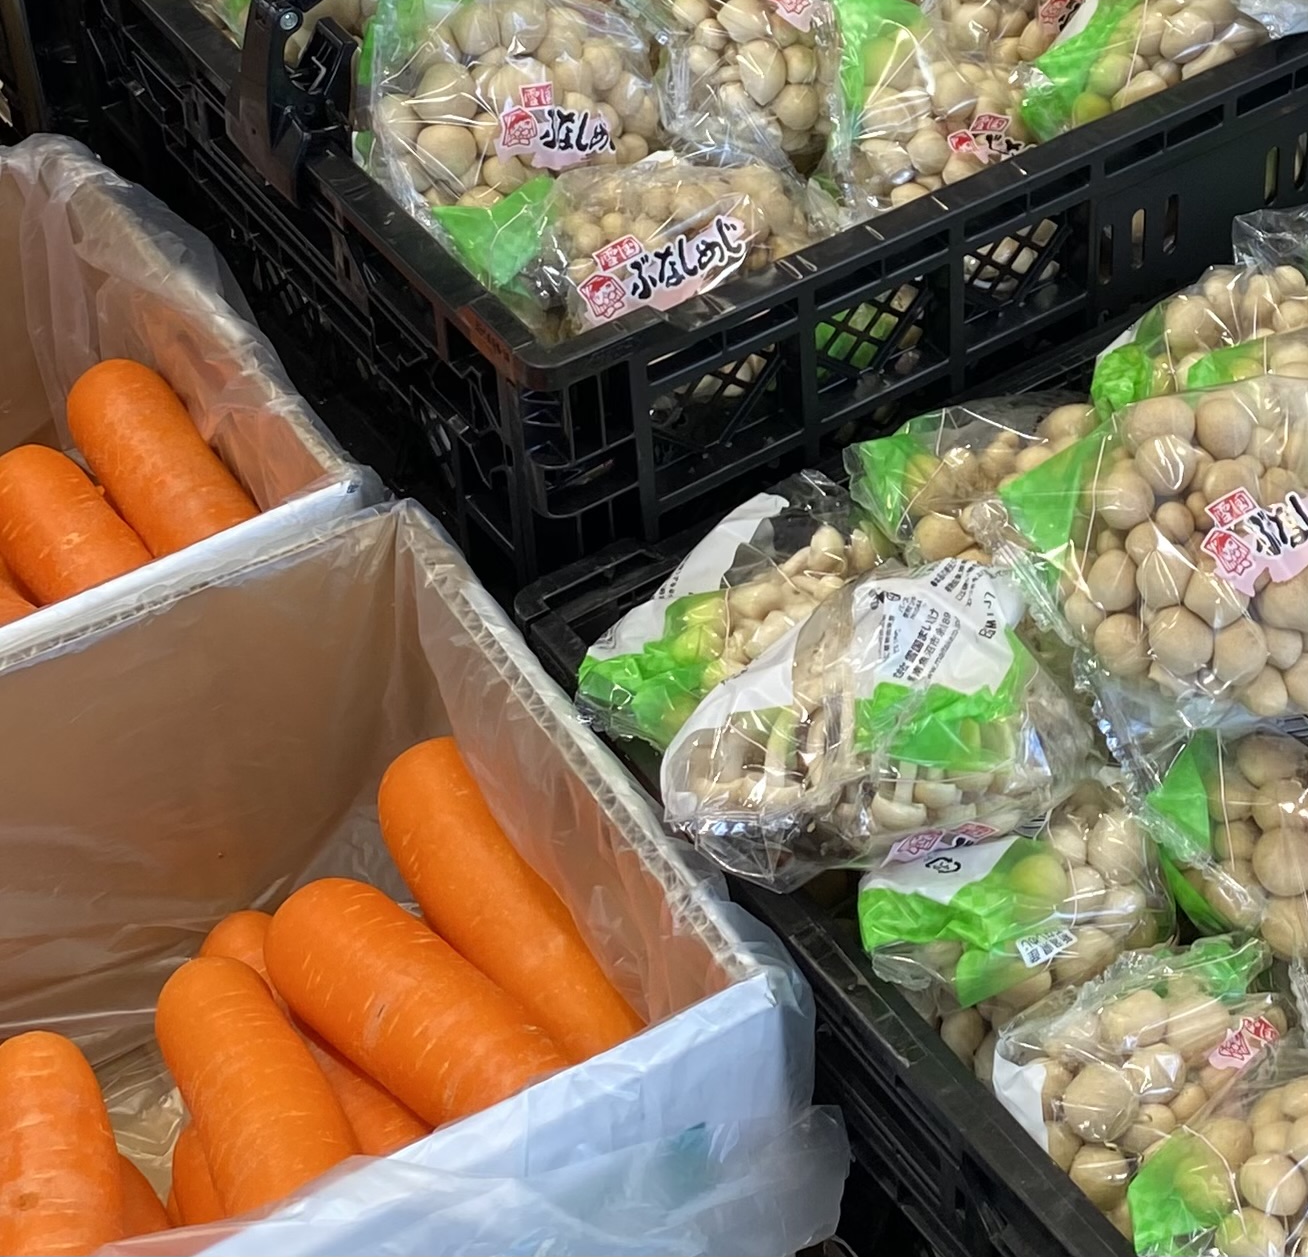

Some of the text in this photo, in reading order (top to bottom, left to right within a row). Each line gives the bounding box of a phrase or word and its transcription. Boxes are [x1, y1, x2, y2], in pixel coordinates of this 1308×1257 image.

[630, 217, 744, 300] ぶなしめじ
